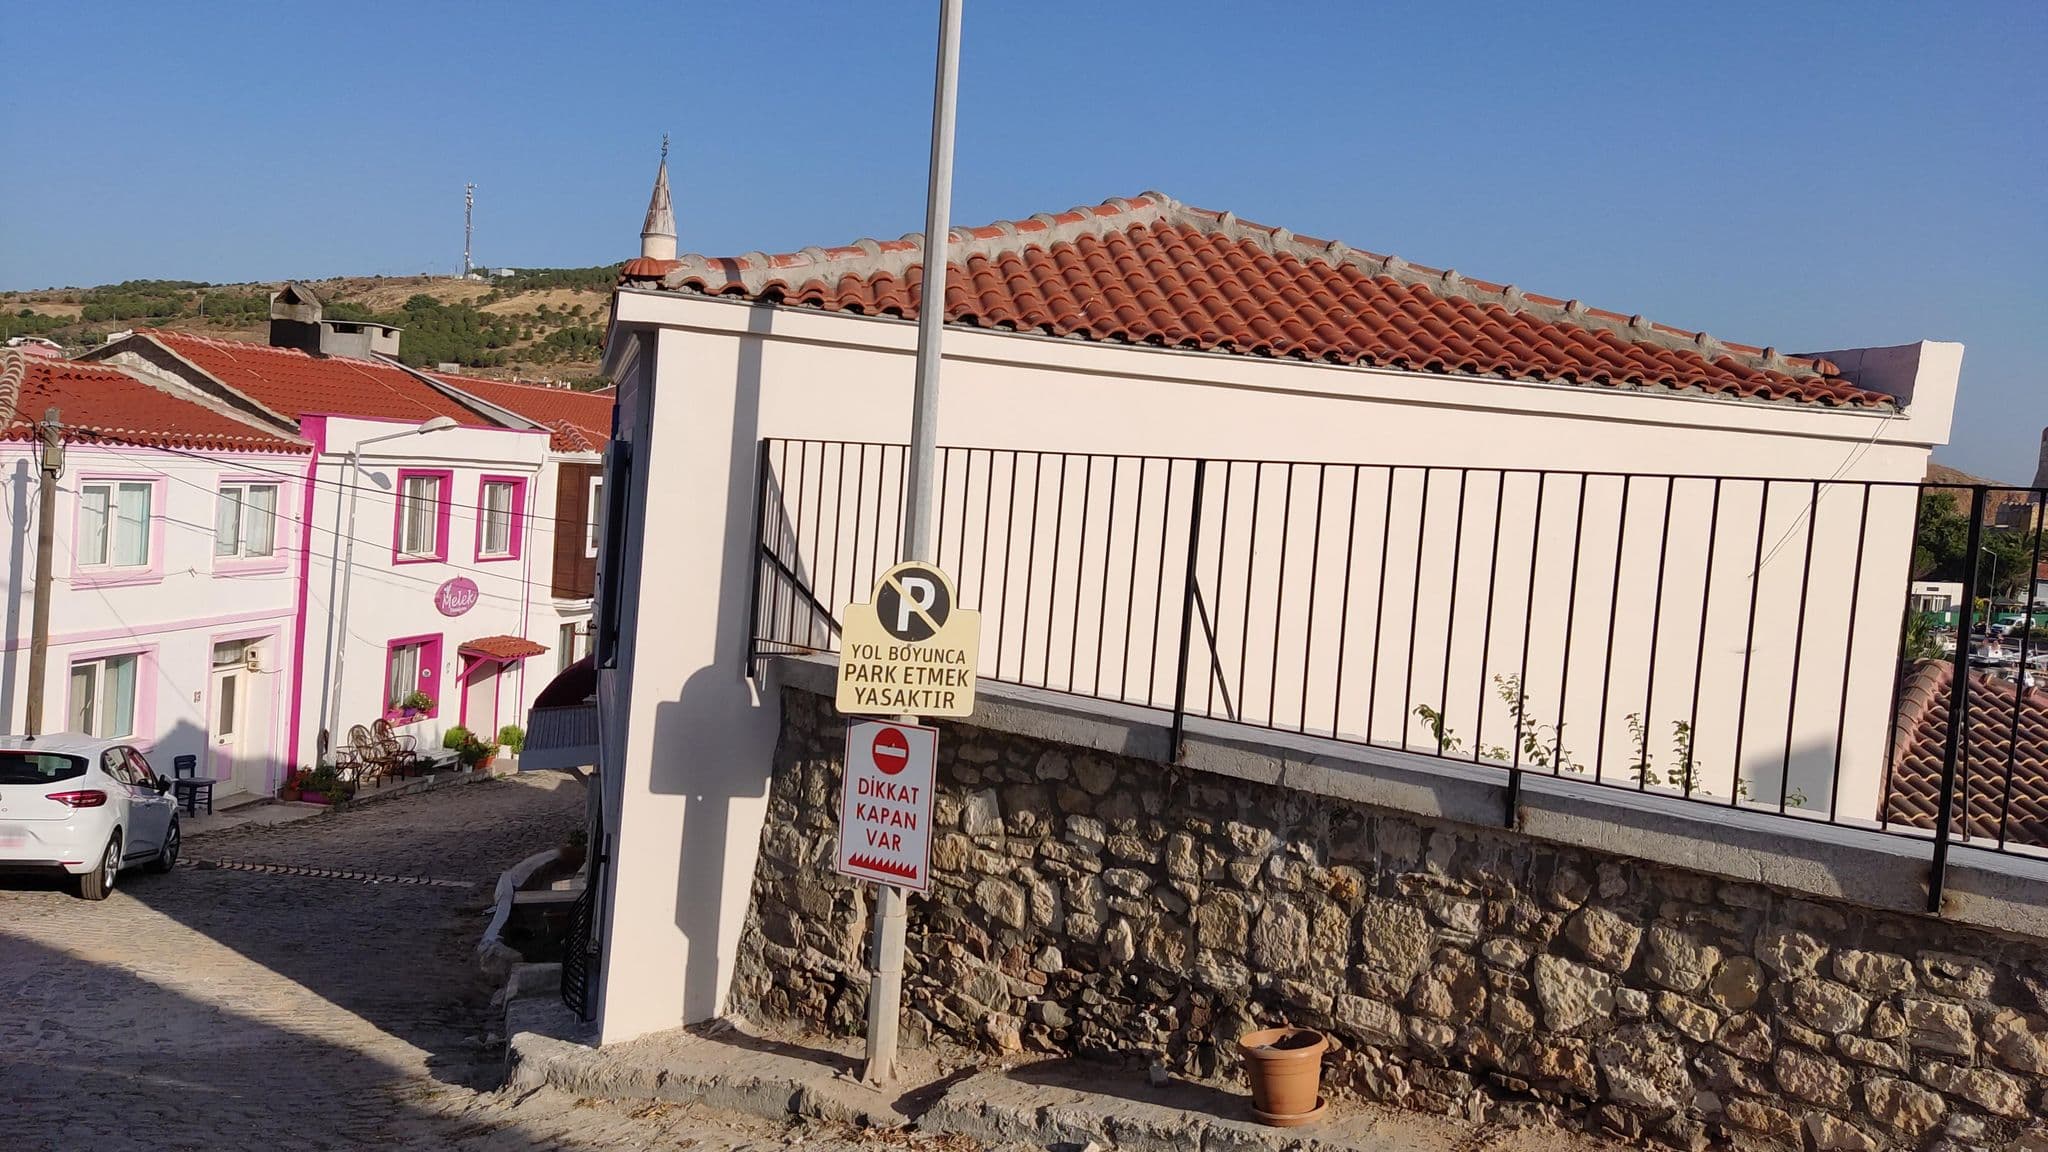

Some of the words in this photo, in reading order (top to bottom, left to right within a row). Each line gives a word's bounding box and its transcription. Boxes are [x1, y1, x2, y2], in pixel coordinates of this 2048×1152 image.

[441, 587, 475, 609] Melek
[852, 644, 882, 660] YOL
[889, 646, 966, 665] BOYUNCA
[844, 664, 898, 684] PARK
[904, 667, 970, 687] ETMEK
[855, 687, 955, 709] YASAKTIR
[858, 776, 919, 805] DİKKAT
[856, 803, 917, 831] KAPAN
[866, 828, 901, 852] VAR
